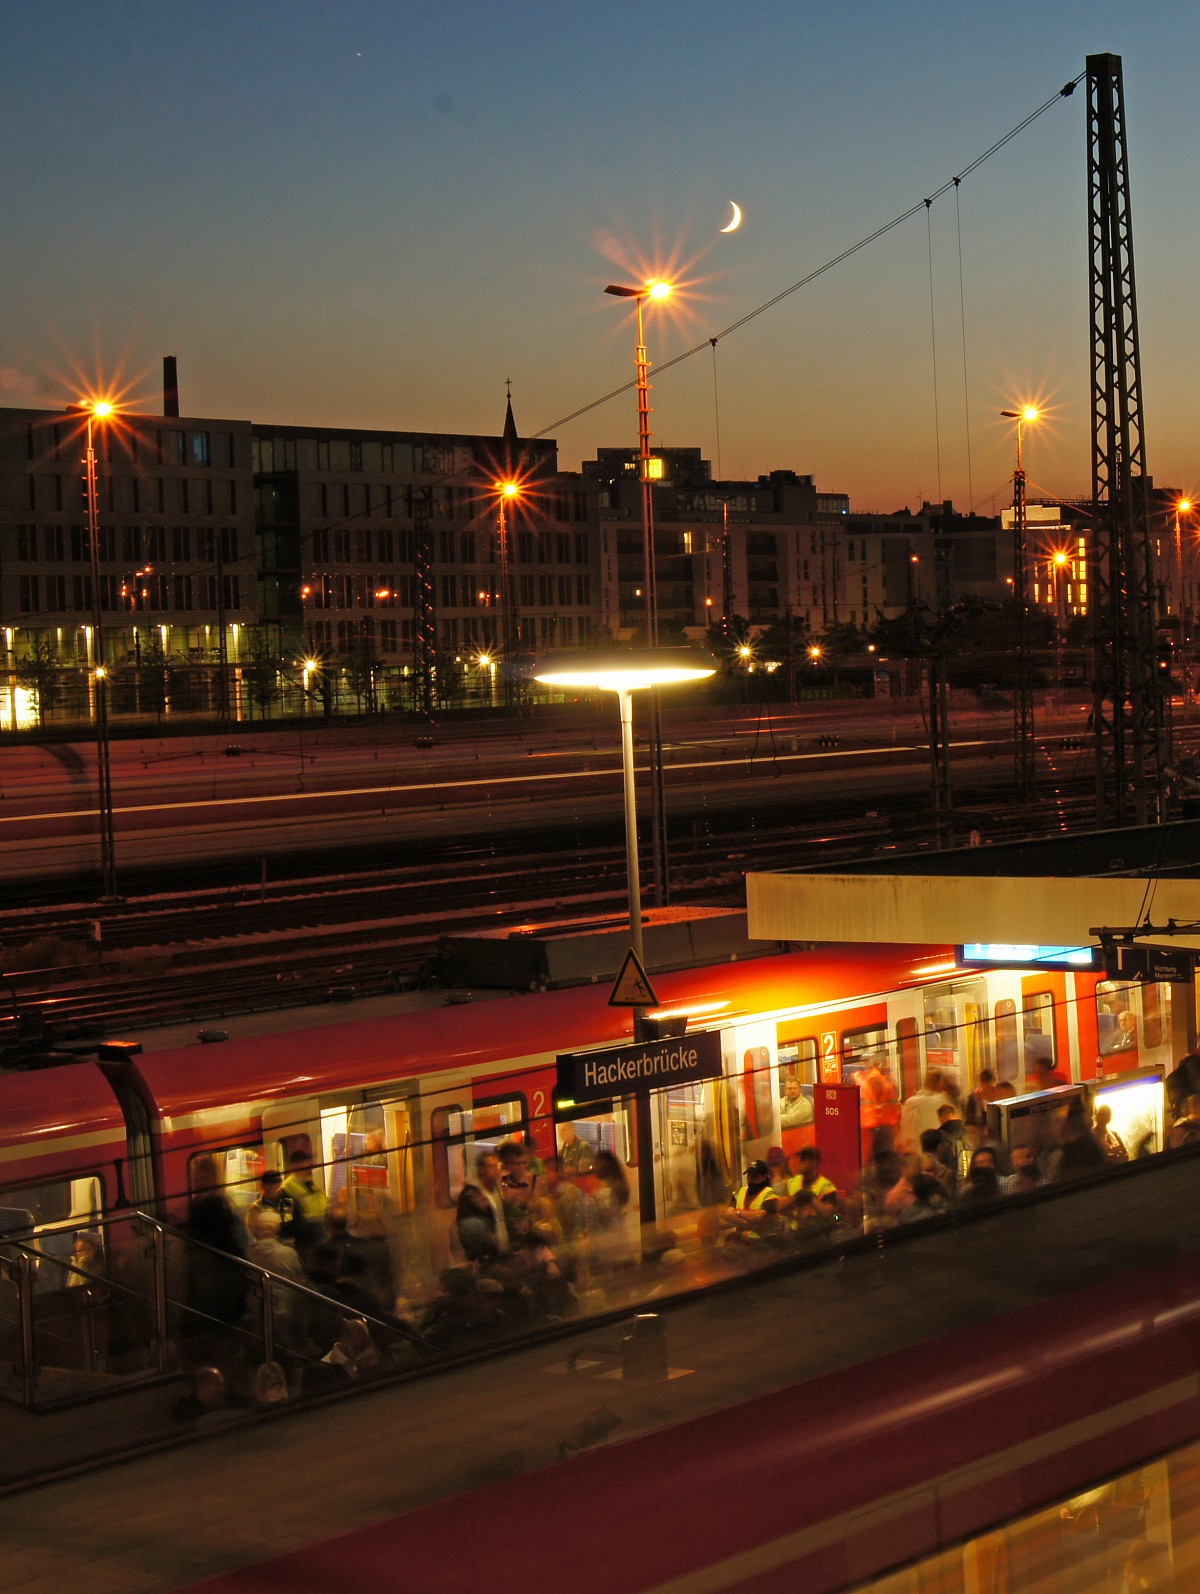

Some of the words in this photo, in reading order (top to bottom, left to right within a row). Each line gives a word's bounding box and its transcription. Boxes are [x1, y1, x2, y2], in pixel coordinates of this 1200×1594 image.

[823, 1034, 835, 1060] 2
[585, 1046, 698, 1087] Hackerbrücke
[533, 1090, 546, 1118] 2
[825, 1107, 839, 1116] SOS
